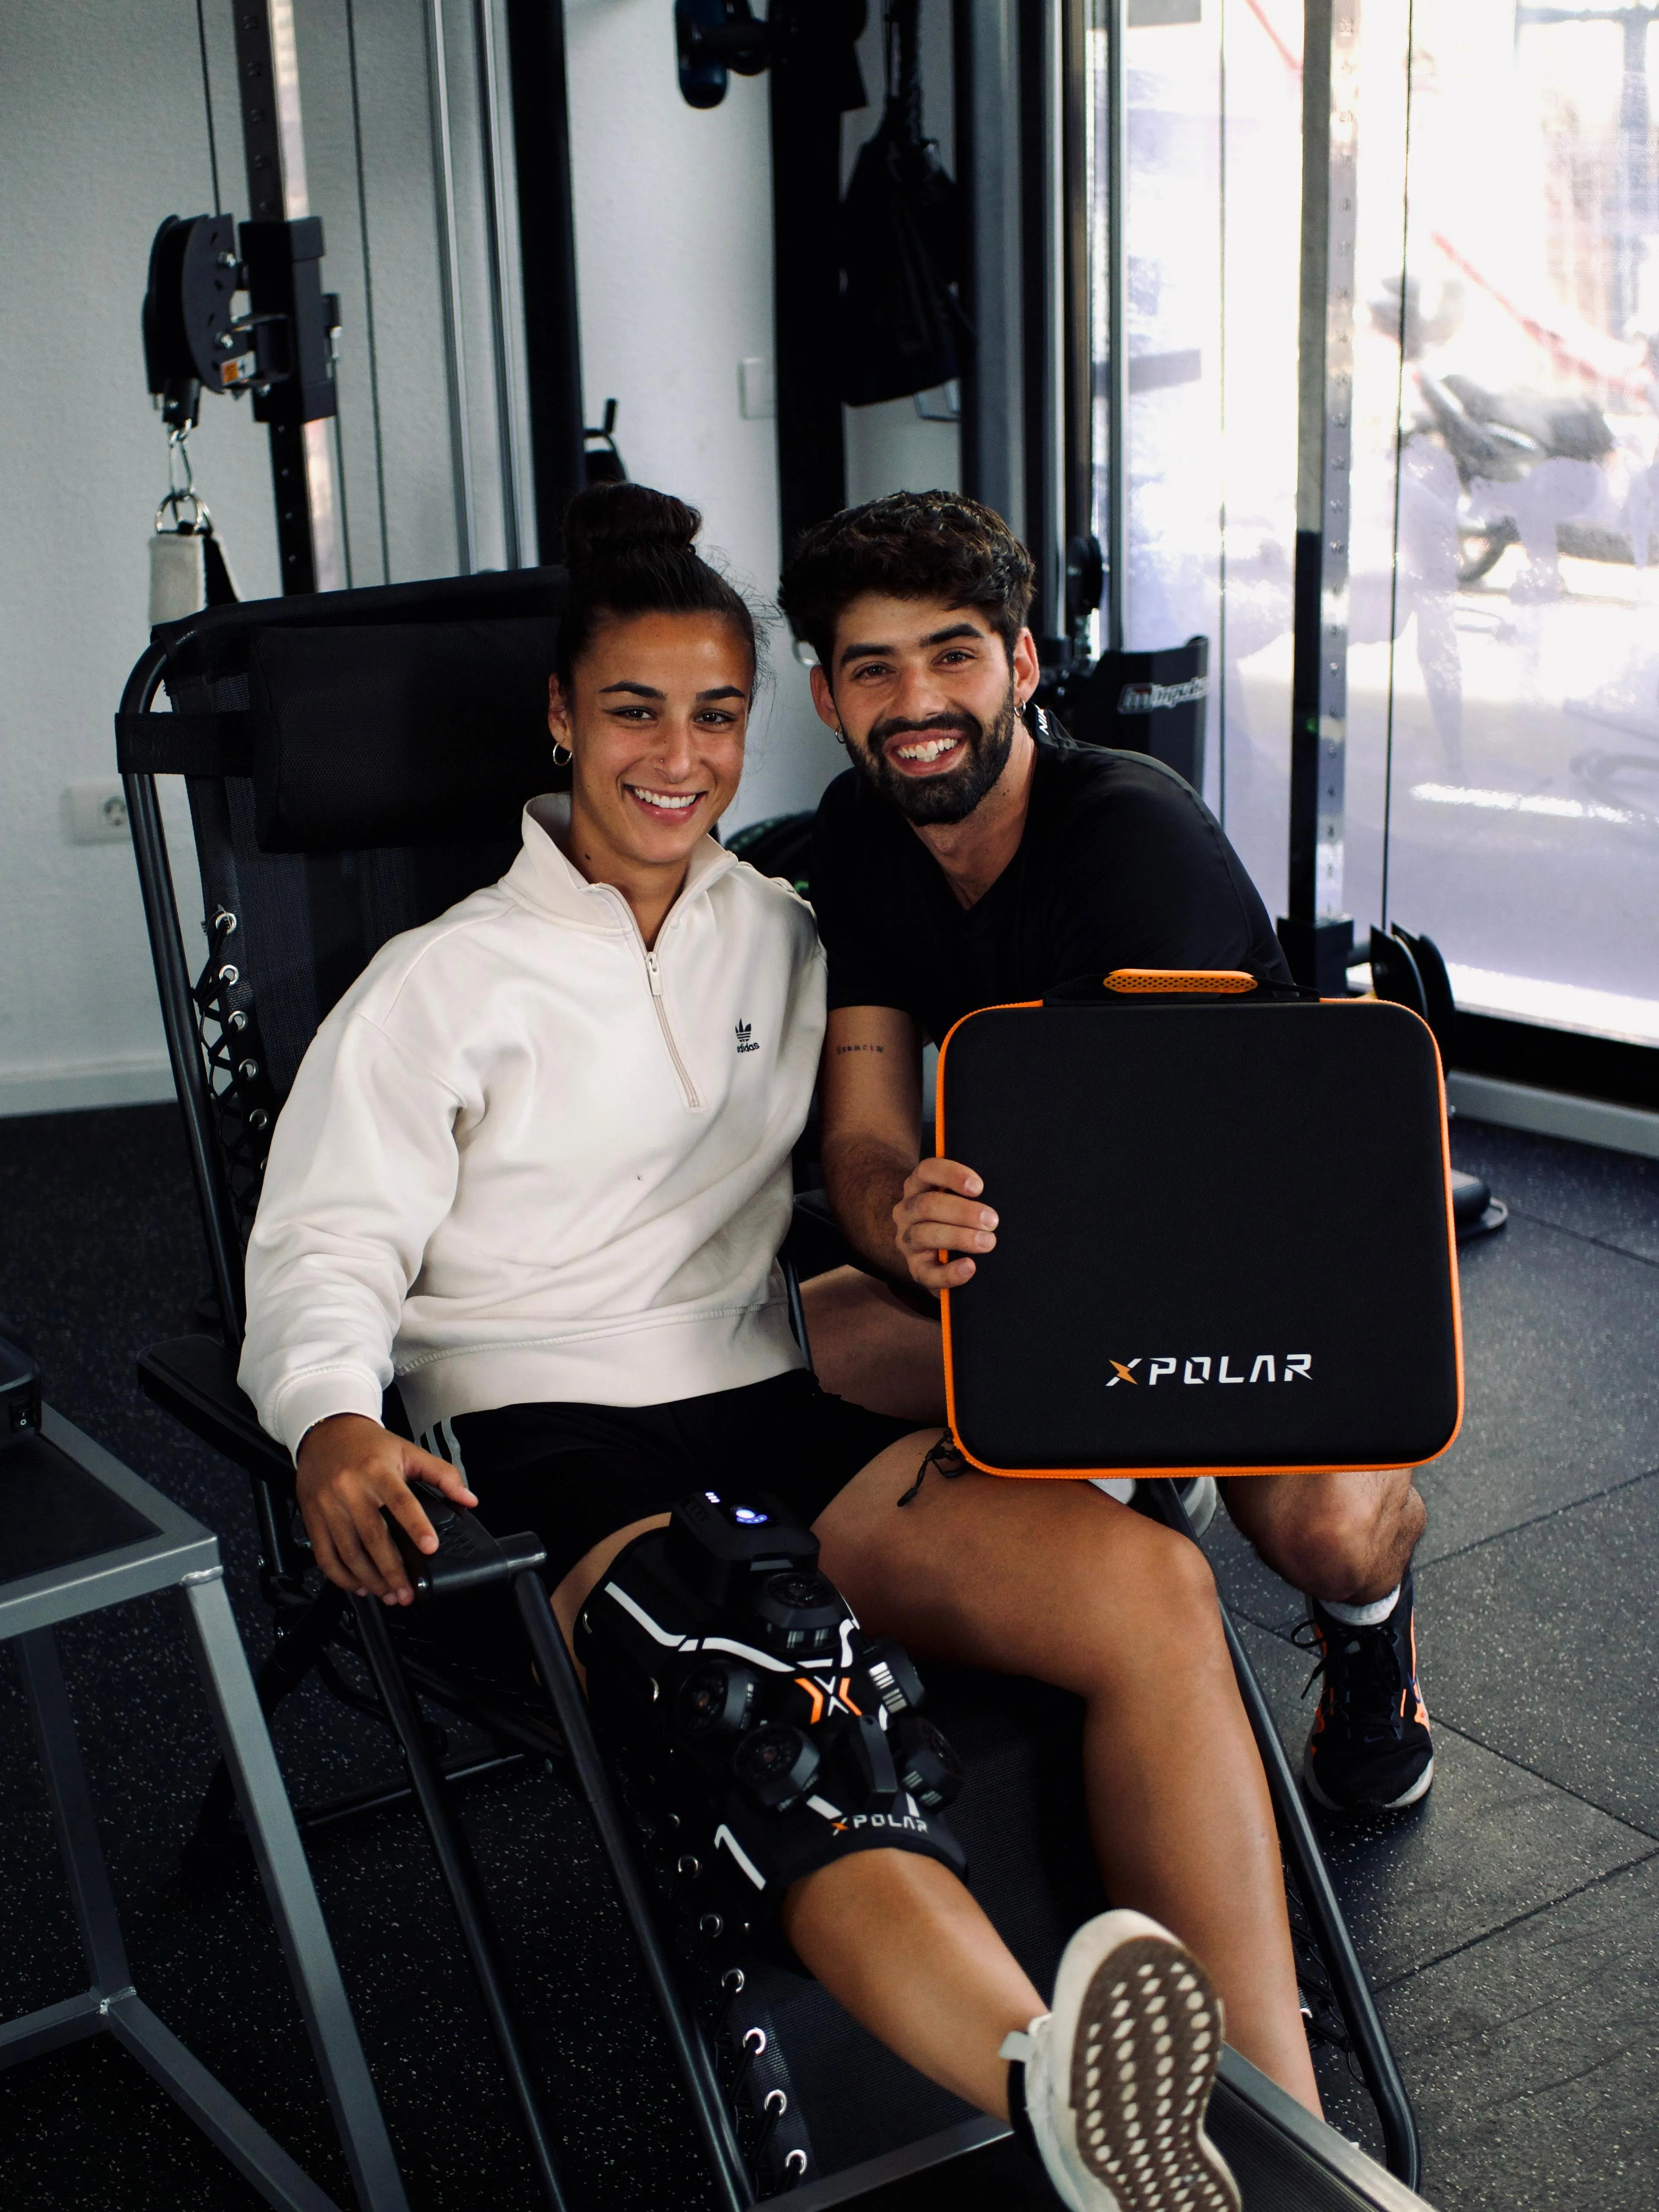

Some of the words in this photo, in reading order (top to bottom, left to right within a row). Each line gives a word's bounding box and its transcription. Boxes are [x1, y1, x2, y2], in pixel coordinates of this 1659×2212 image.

[1034, 704, 1049, 736] NIK
[737, 1042, 760, 1053] adidas
[1105, 1354, 1313, 1386] XPOLAR
[830, 1814, 928, 1836] XPOLAR
